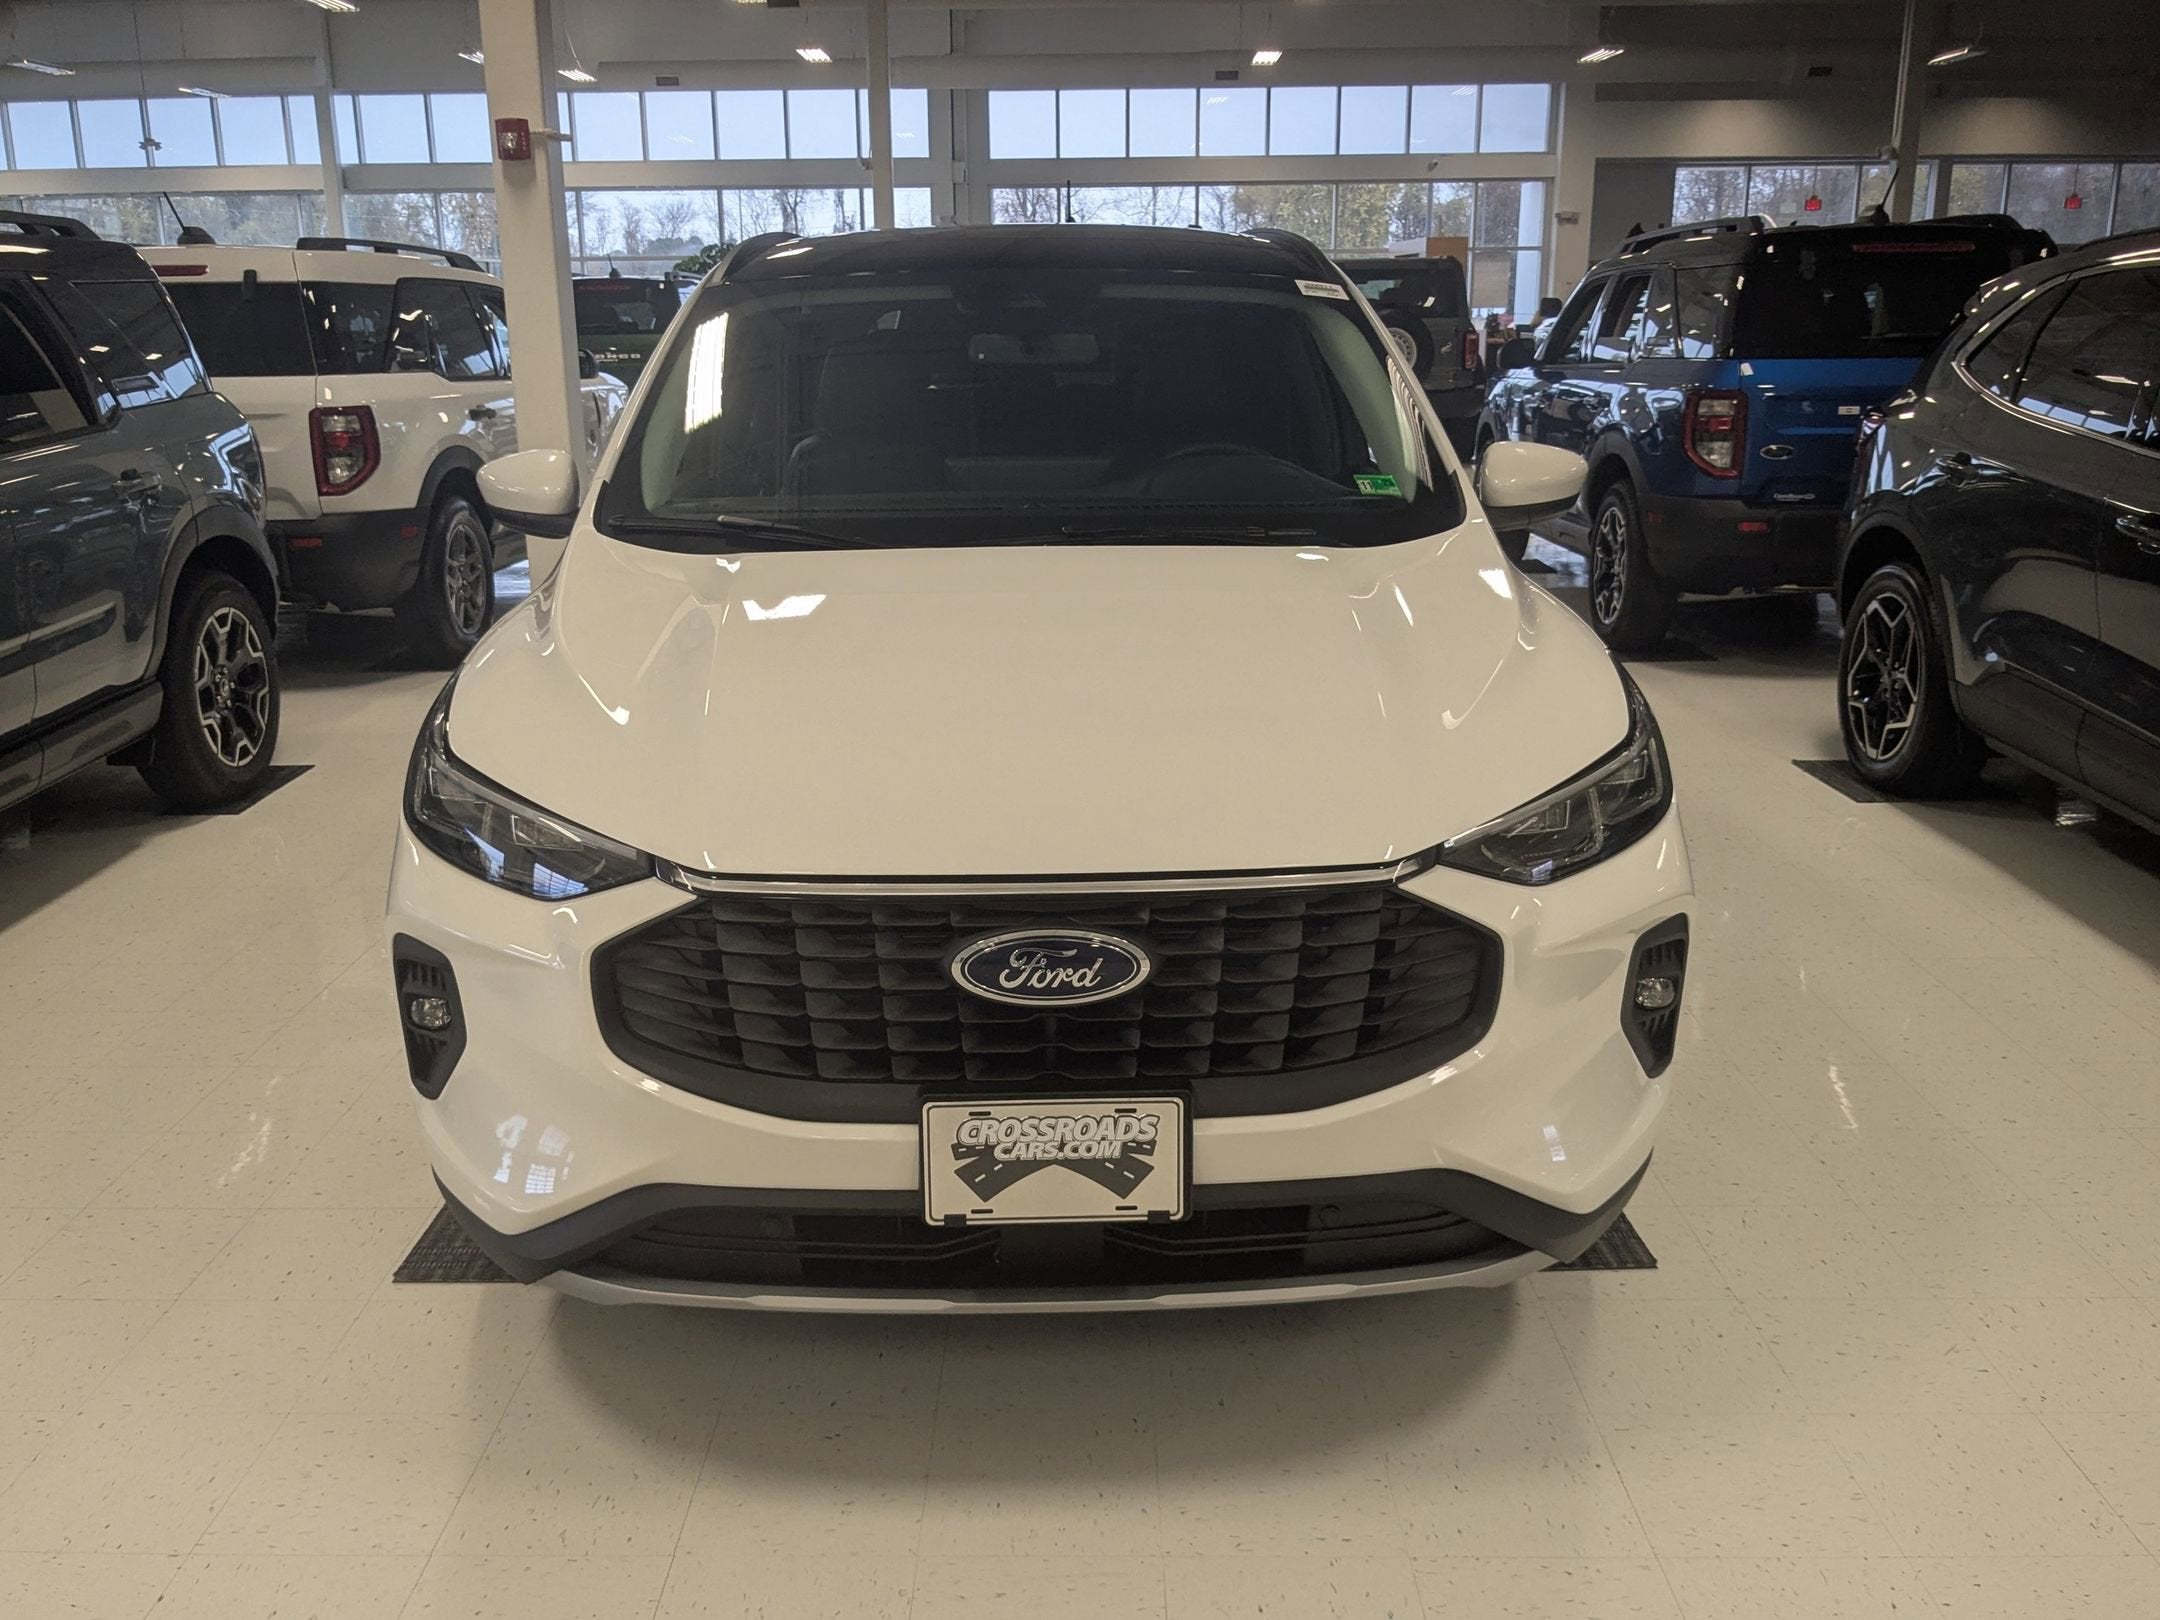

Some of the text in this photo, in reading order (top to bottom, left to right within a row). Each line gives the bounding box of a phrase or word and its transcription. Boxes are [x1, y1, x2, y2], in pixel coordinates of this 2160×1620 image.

[999, 948, 1103, 989] Ford
[956, 1115, 1160, 1145] CROSSROADS
[994, 1141, 1123, 1161] CARS.COM
